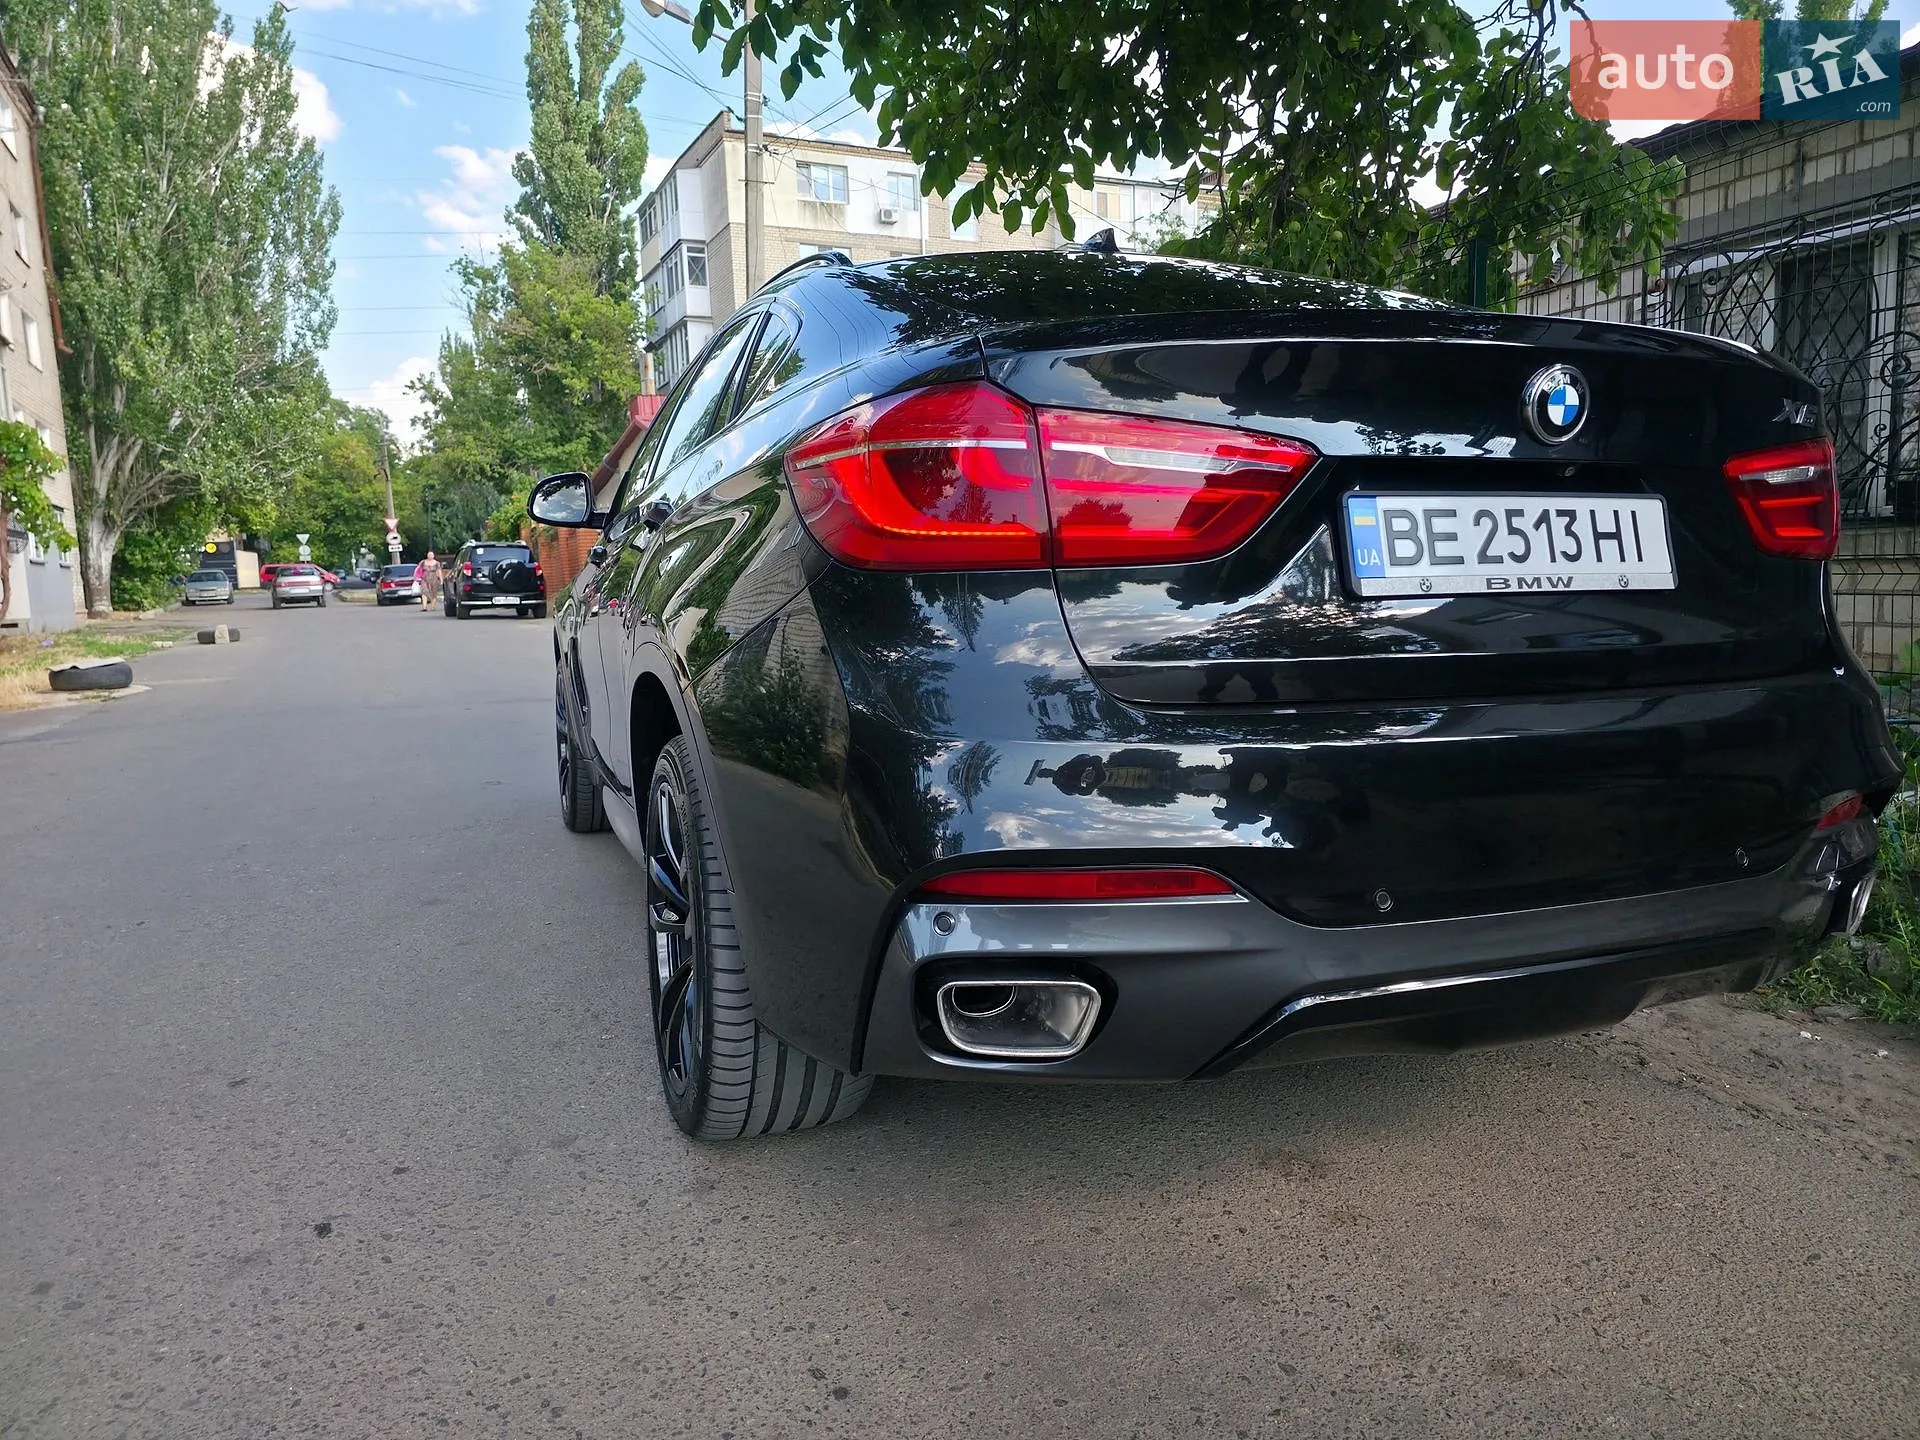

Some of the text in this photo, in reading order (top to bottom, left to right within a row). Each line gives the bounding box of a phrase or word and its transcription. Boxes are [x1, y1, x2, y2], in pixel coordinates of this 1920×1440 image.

[1543, 373, 1584, 394] BMW
[1383, 509, 1643, 566] BE 2513 HI
[1358, 549, 1381, 566] UA
[1486, 576, 1574, 590] BMW
